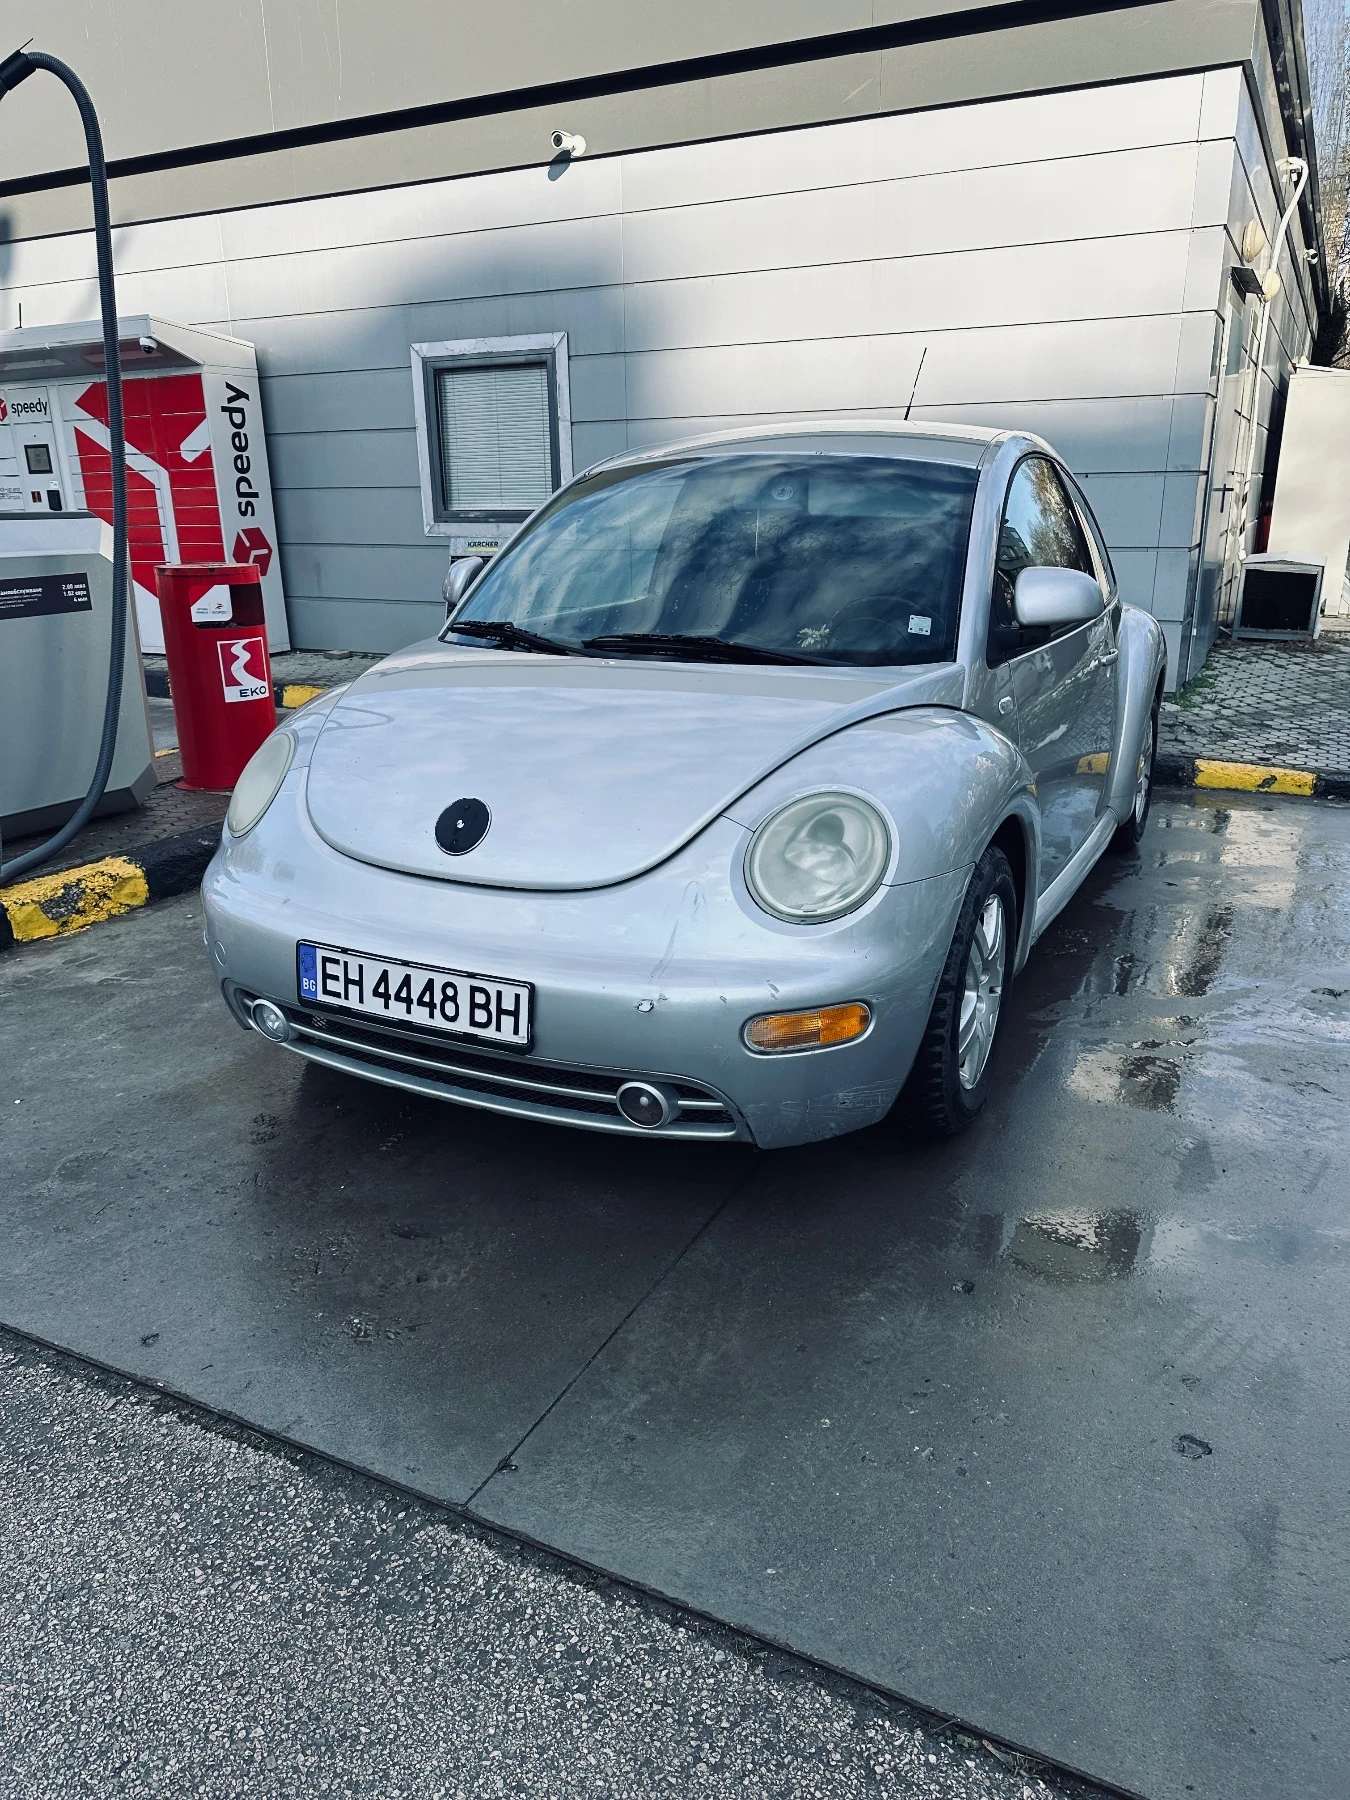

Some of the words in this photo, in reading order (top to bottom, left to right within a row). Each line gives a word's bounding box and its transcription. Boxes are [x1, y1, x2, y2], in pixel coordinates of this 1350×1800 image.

[11, 398, 47, 417] speedy
[221, 381, 259, 516] speedy
[0, 588, 42, 596] амообслужване
[239, 686, 267, 697] EKO
[303, 978, 316, 991] BG
[321, 955, 364, 1004] EH
[372, 969, 459, 1022] 4448
[469, 984, 520, 1035] BH
